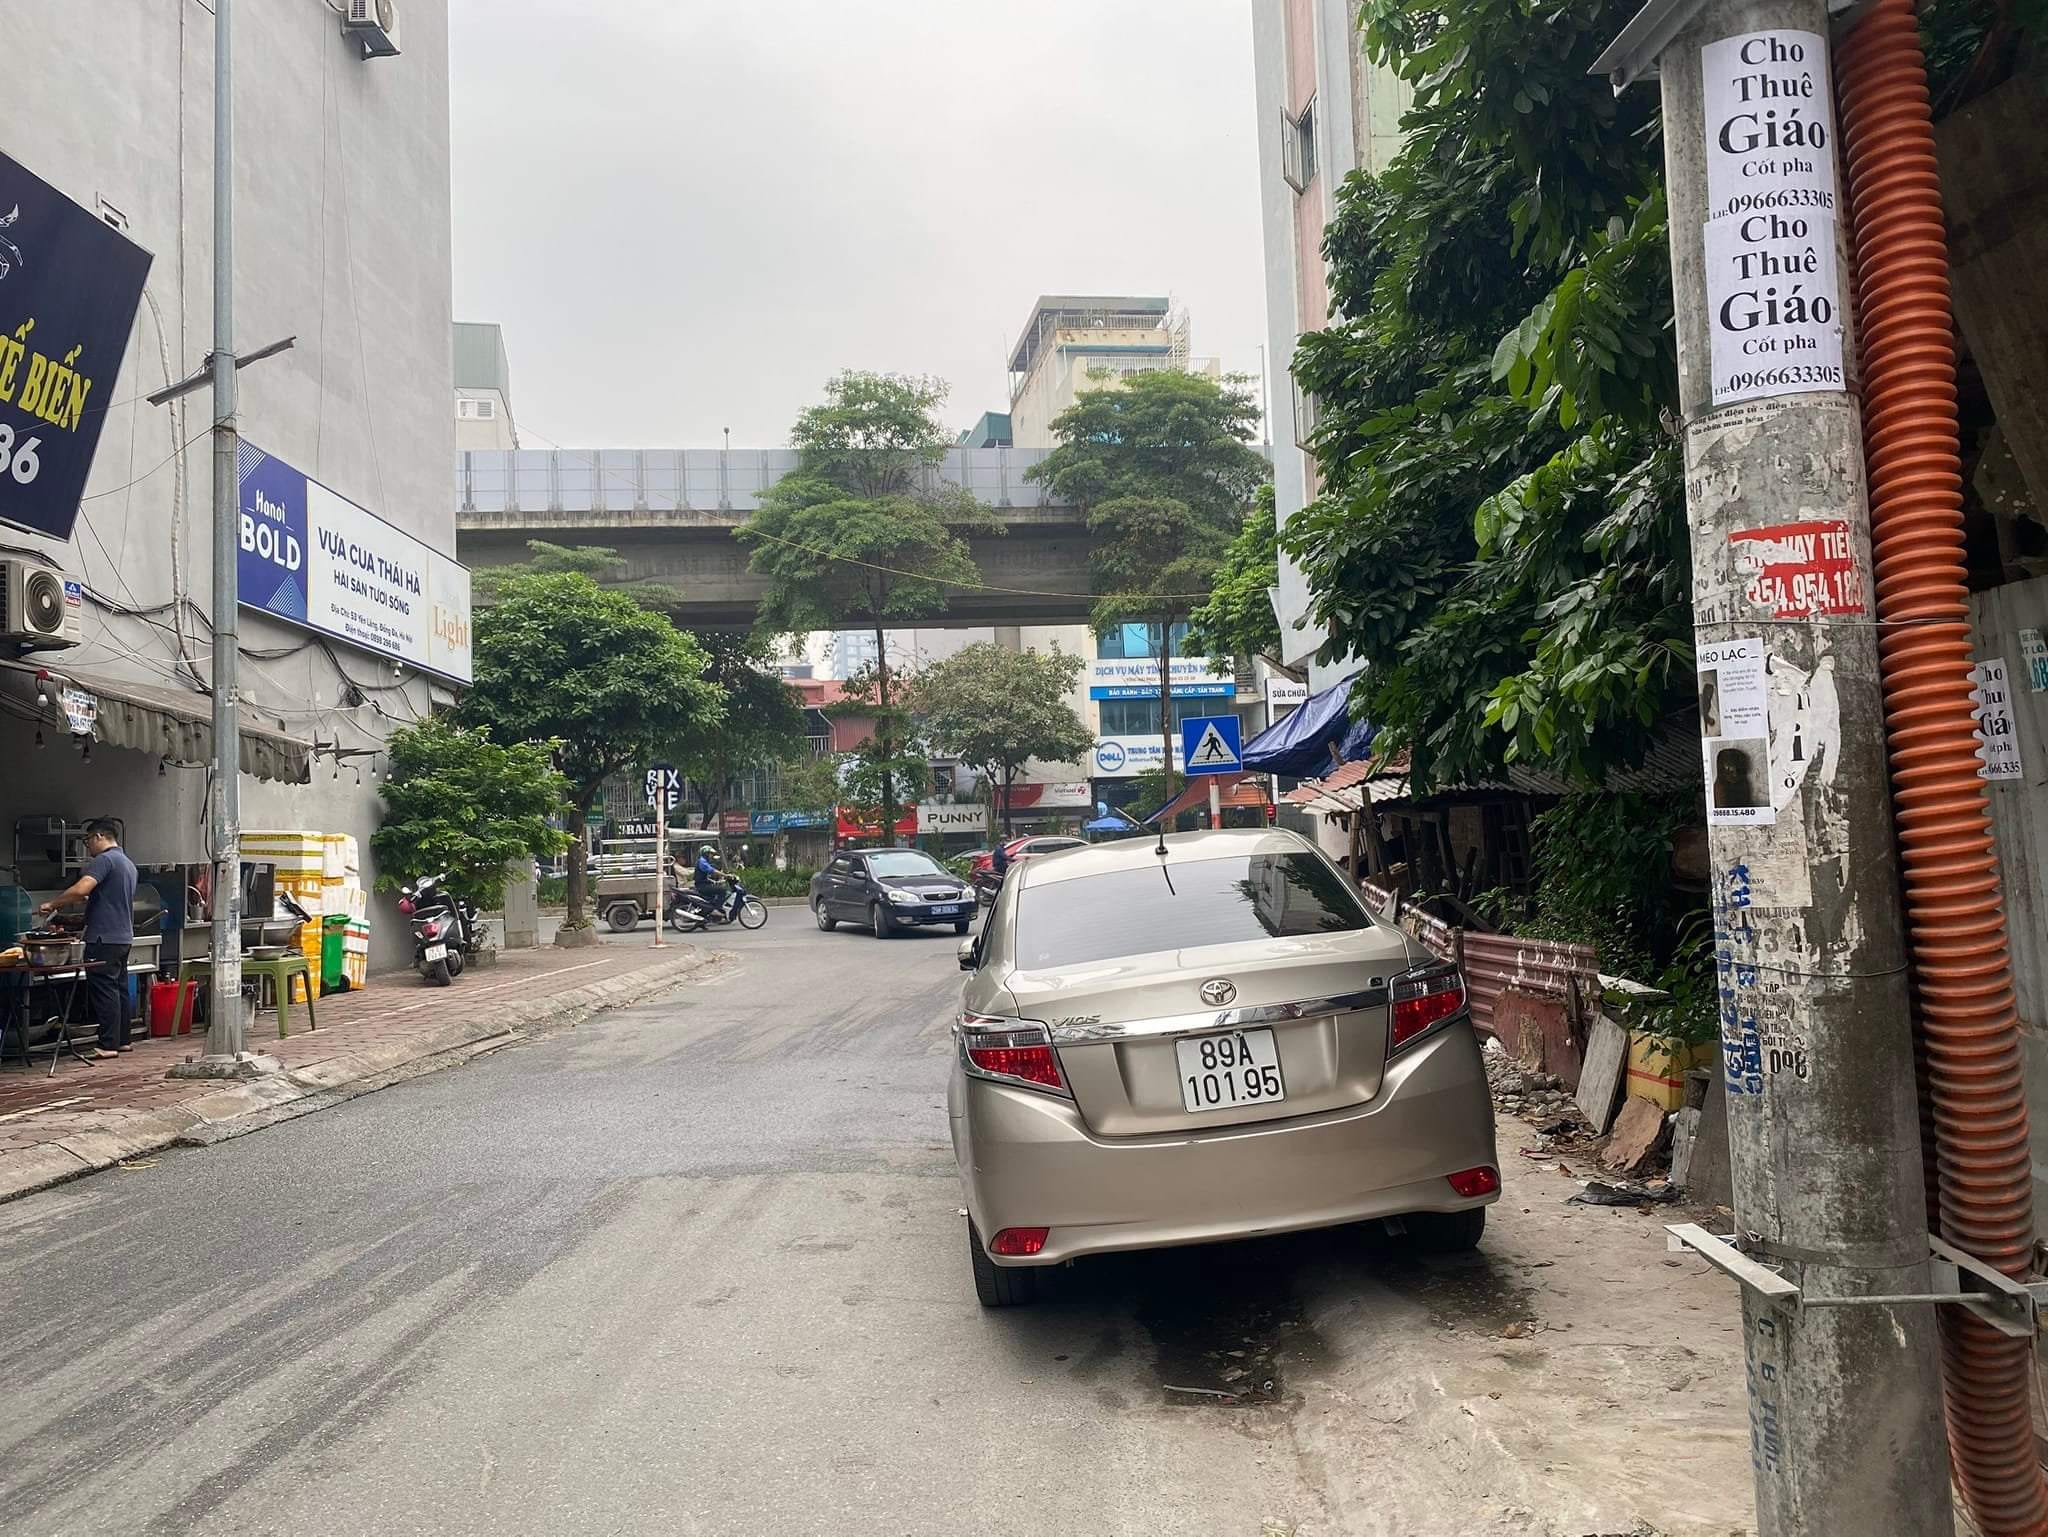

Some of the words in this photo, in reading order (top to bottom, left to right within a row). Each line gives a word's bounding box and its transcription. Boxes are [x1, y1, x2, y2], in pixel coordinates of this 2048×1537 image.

[1740, 37, 1804, 65] Cho
[1733, 72, 1813, 103] Thuê
[1719, 108, 1826, 154] Giáo
[1742, 157, 1777, 177] Cốt
[1783, 157, 1813, 176] pha
[1740, 214, 1808, 242] Cho
[1733, 246, 1817, 280] Thuê
[1720, 285, 1832, 332] Giáo
[1743, 336, 1777, 355] Cốt
[1784, 334, 1817, 354] pha
[0, 317, 26, 403] Ế
[17, 343, 92, 433] BIẾN
[255, 488, 287, 526] Hanoi
[240, 512, 302, 572] BOLD
[318, 526, 347, 561] VỰA
[349, 543, 375, 575] CUA
[377, 557, 404, 588] THÁI
[405, 570, 421, 597] HÀ
[432, 604, 469, 650] Light
[1095, 666, 1114, 677] DỊCH
[1115, 665, 1127, 676] VỤ
[1146, 664, 1161, 674] TÍN
[1980, 666, 2003, 683] ho
[1100, 752, 1123, 762] DELL
[928, 812, 983, 824] PUNNY
[1199, 1036, 1254, 1071] 89A
[1187, 1065, 1280, 1108] 101.95
